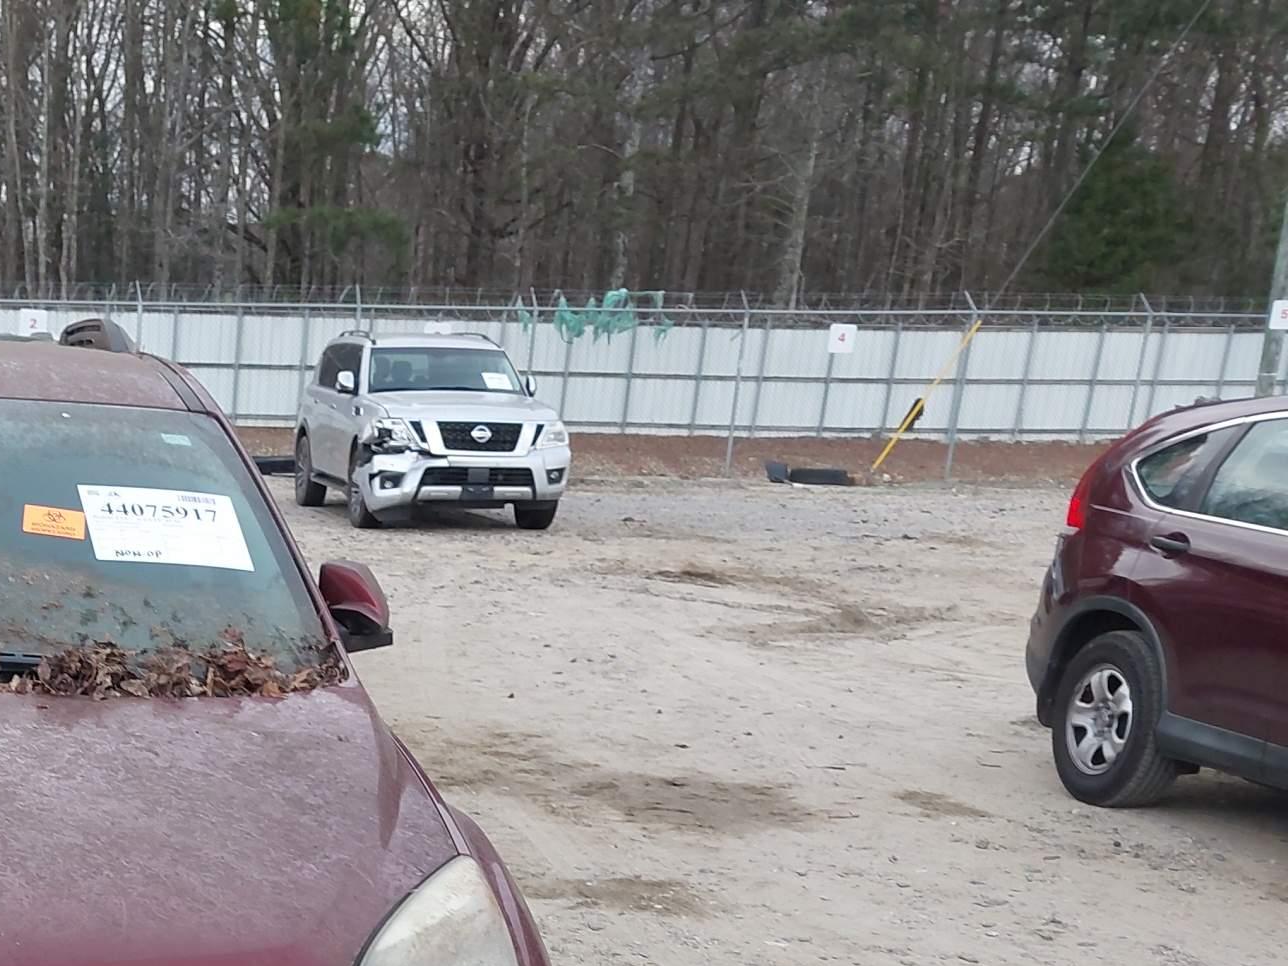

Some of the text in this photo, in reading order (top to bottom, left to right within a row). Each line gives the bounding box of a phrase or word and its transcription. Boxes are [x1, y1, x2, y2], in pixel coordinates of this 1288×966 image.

[29, 318, 38, 329] 2
[838, 332, 846, 343] 4
[100, 502, 217, 522] 44075917
